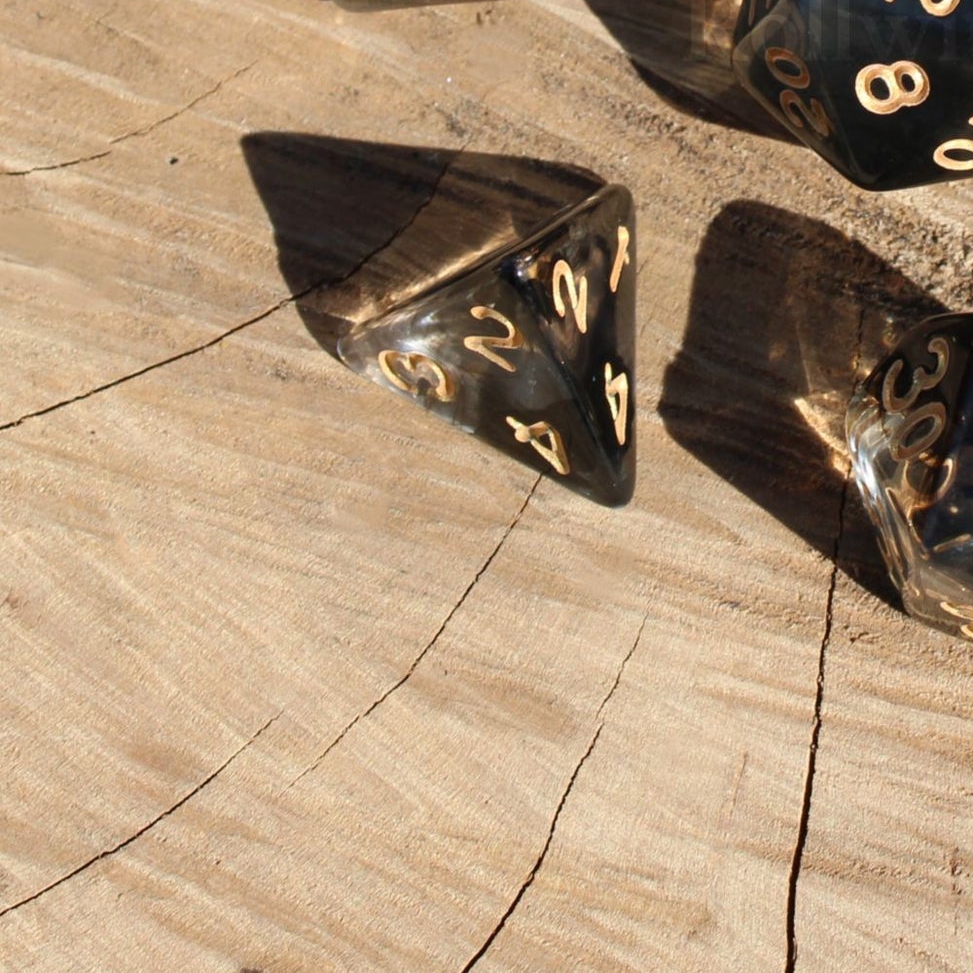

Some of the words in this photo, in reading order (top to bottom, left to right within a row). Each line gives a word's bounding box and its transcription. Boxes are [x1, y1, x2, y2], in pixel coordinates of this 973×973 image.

[855, 60, 931, 115] 8
[552, 259, 589, 334] 2
[463, 305, 524, 373] 2
[604, 362, 629, 446] 4
[505, 415, 571, 476] 4
